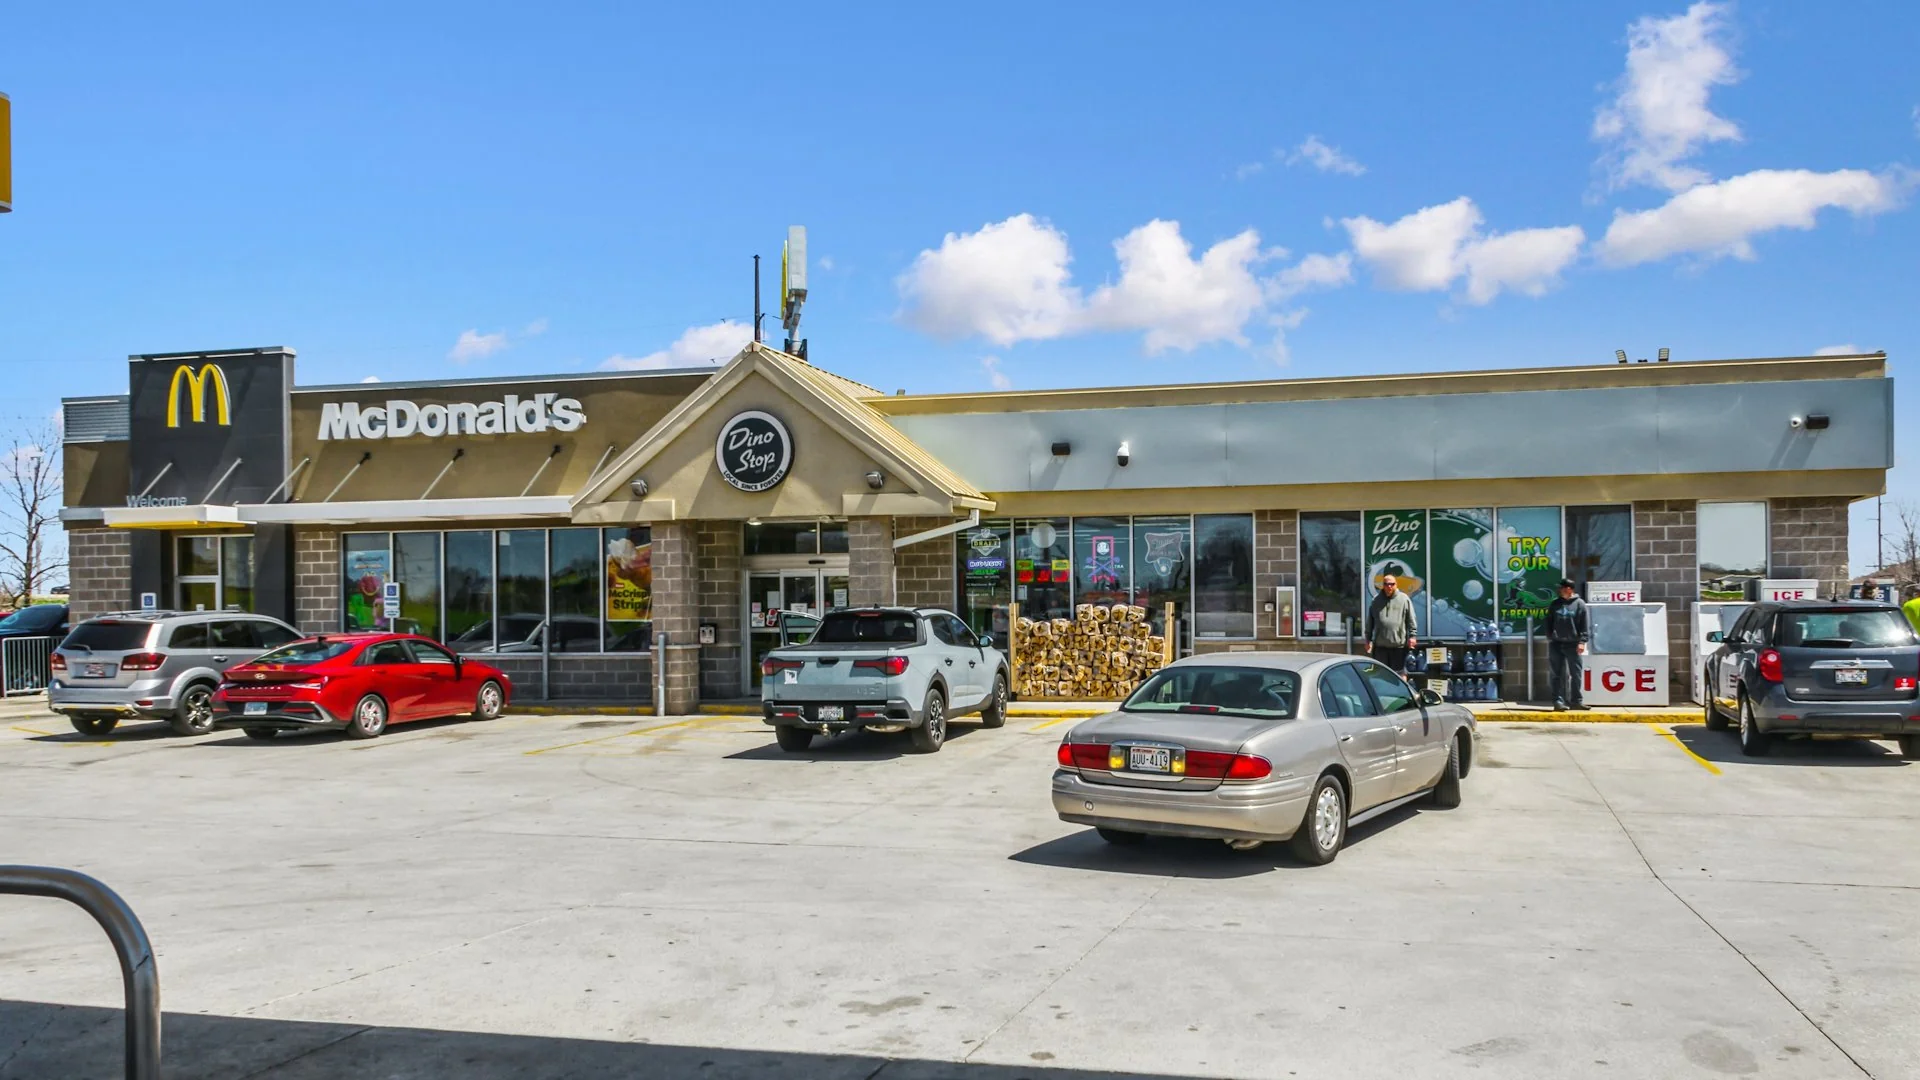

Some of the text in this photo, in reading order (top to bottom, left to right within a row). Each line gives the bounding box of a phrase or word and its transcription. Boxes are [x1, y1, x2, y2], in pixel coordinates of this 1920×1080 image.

[317, 392, 585, 441] McDonald's
[729, 427, 775, 450] Dino
[735, 449, 775, 473] Stop
[723, 470, 740, 487] LOCAL
[760, 469, 784, 489] FOREVER
[126, 495, 187, 507] Welcome
[1373, 513, 1421, 535] Dino
[1371, 533, 1419, 556] Wash
[1507, 536, 1550, 555] TRY
[1507, 556, 1550, 572] OUR
[1610, 591, 1636, 602] ICE
[1583, 668, 1656, 692] ICE
